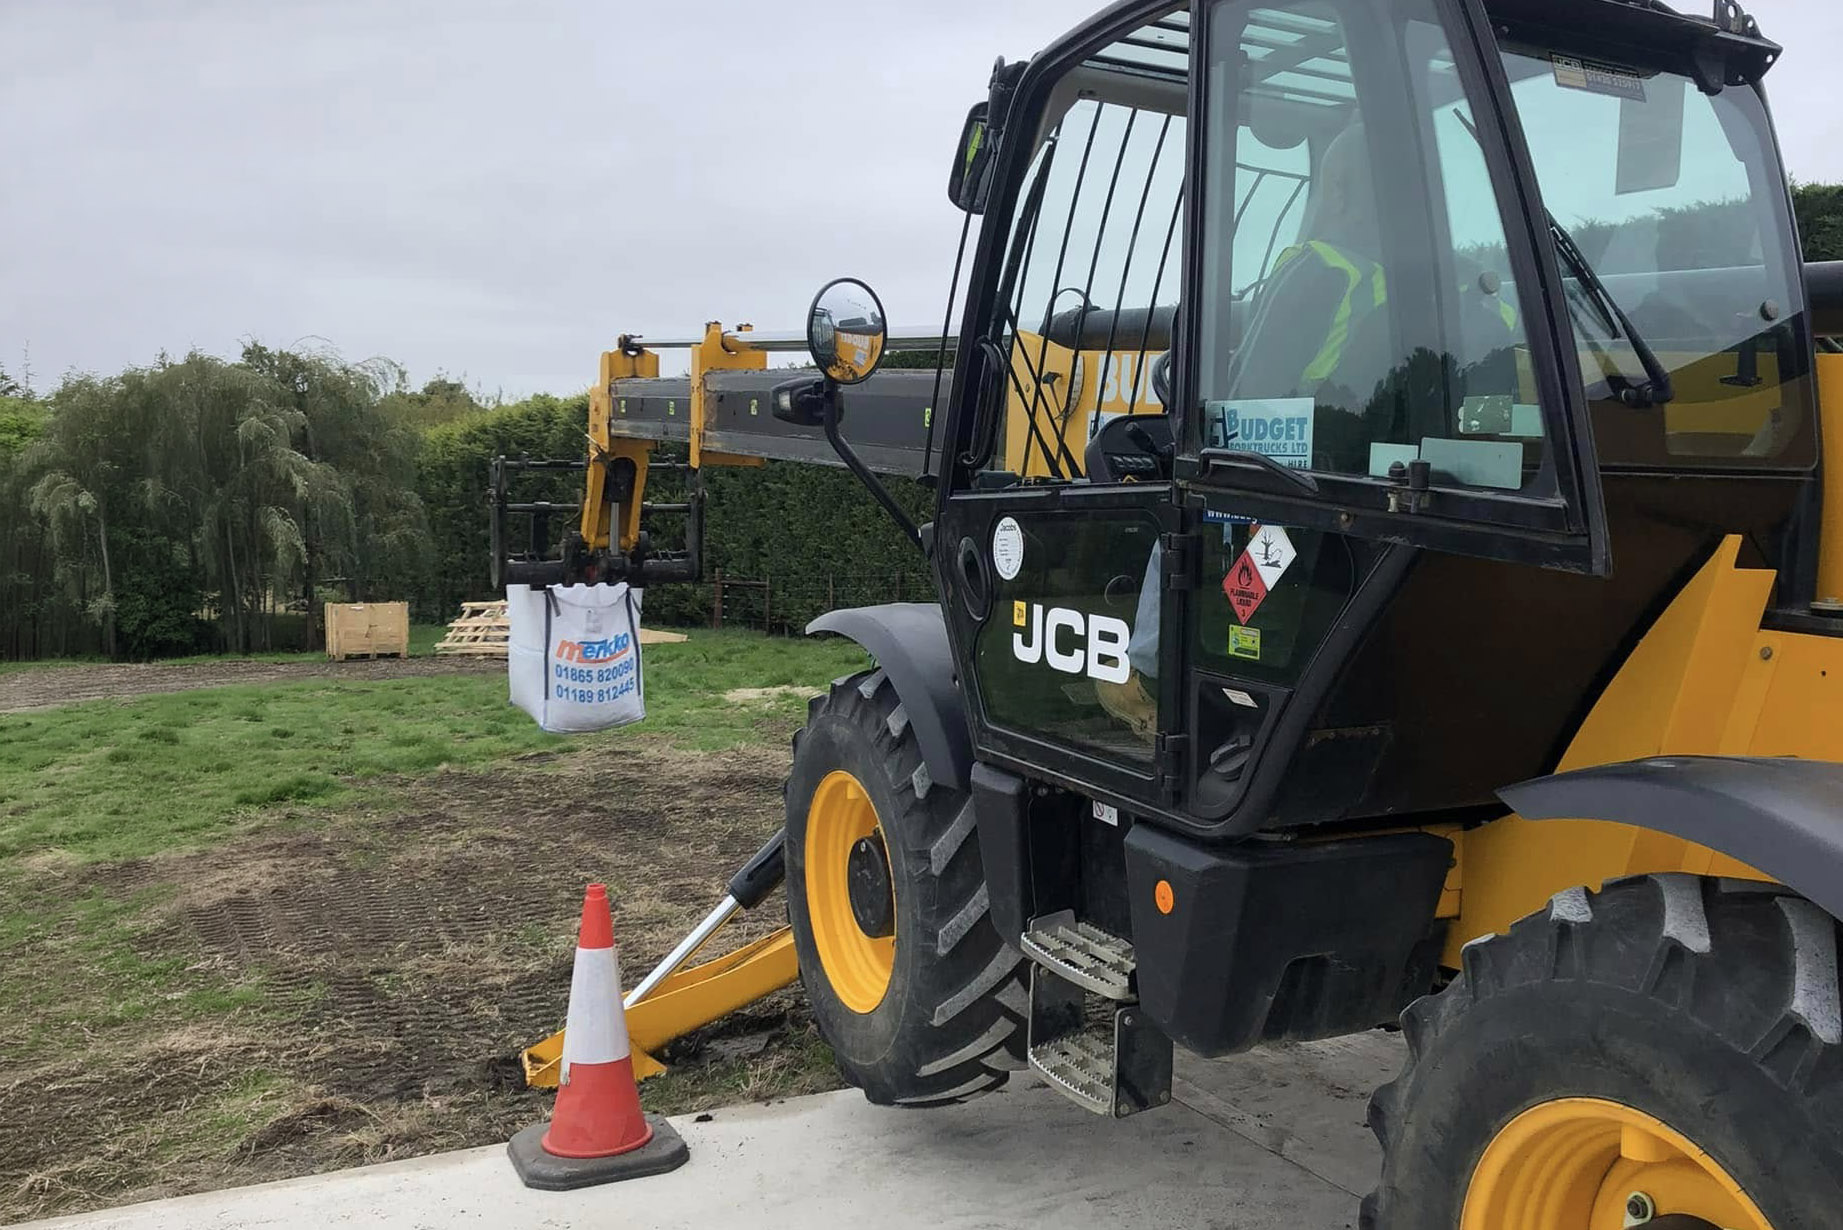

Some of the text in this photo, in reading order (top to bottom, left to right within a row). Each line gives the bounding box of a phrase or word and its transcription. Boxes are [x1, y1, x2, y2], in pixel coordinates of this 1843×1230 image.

[1226, 408, 1308, 441] BUDGET
[1291, 442, 1308, 453] LTD
[1287, 460, 1308, 469] HIRE
[556, 632, 629, 662] merkko
[1013, 602, 1131, 685] JCB
[555, 657, 635, 683] 01865 820090
[556, 677, 635, 703] 01189 812445
